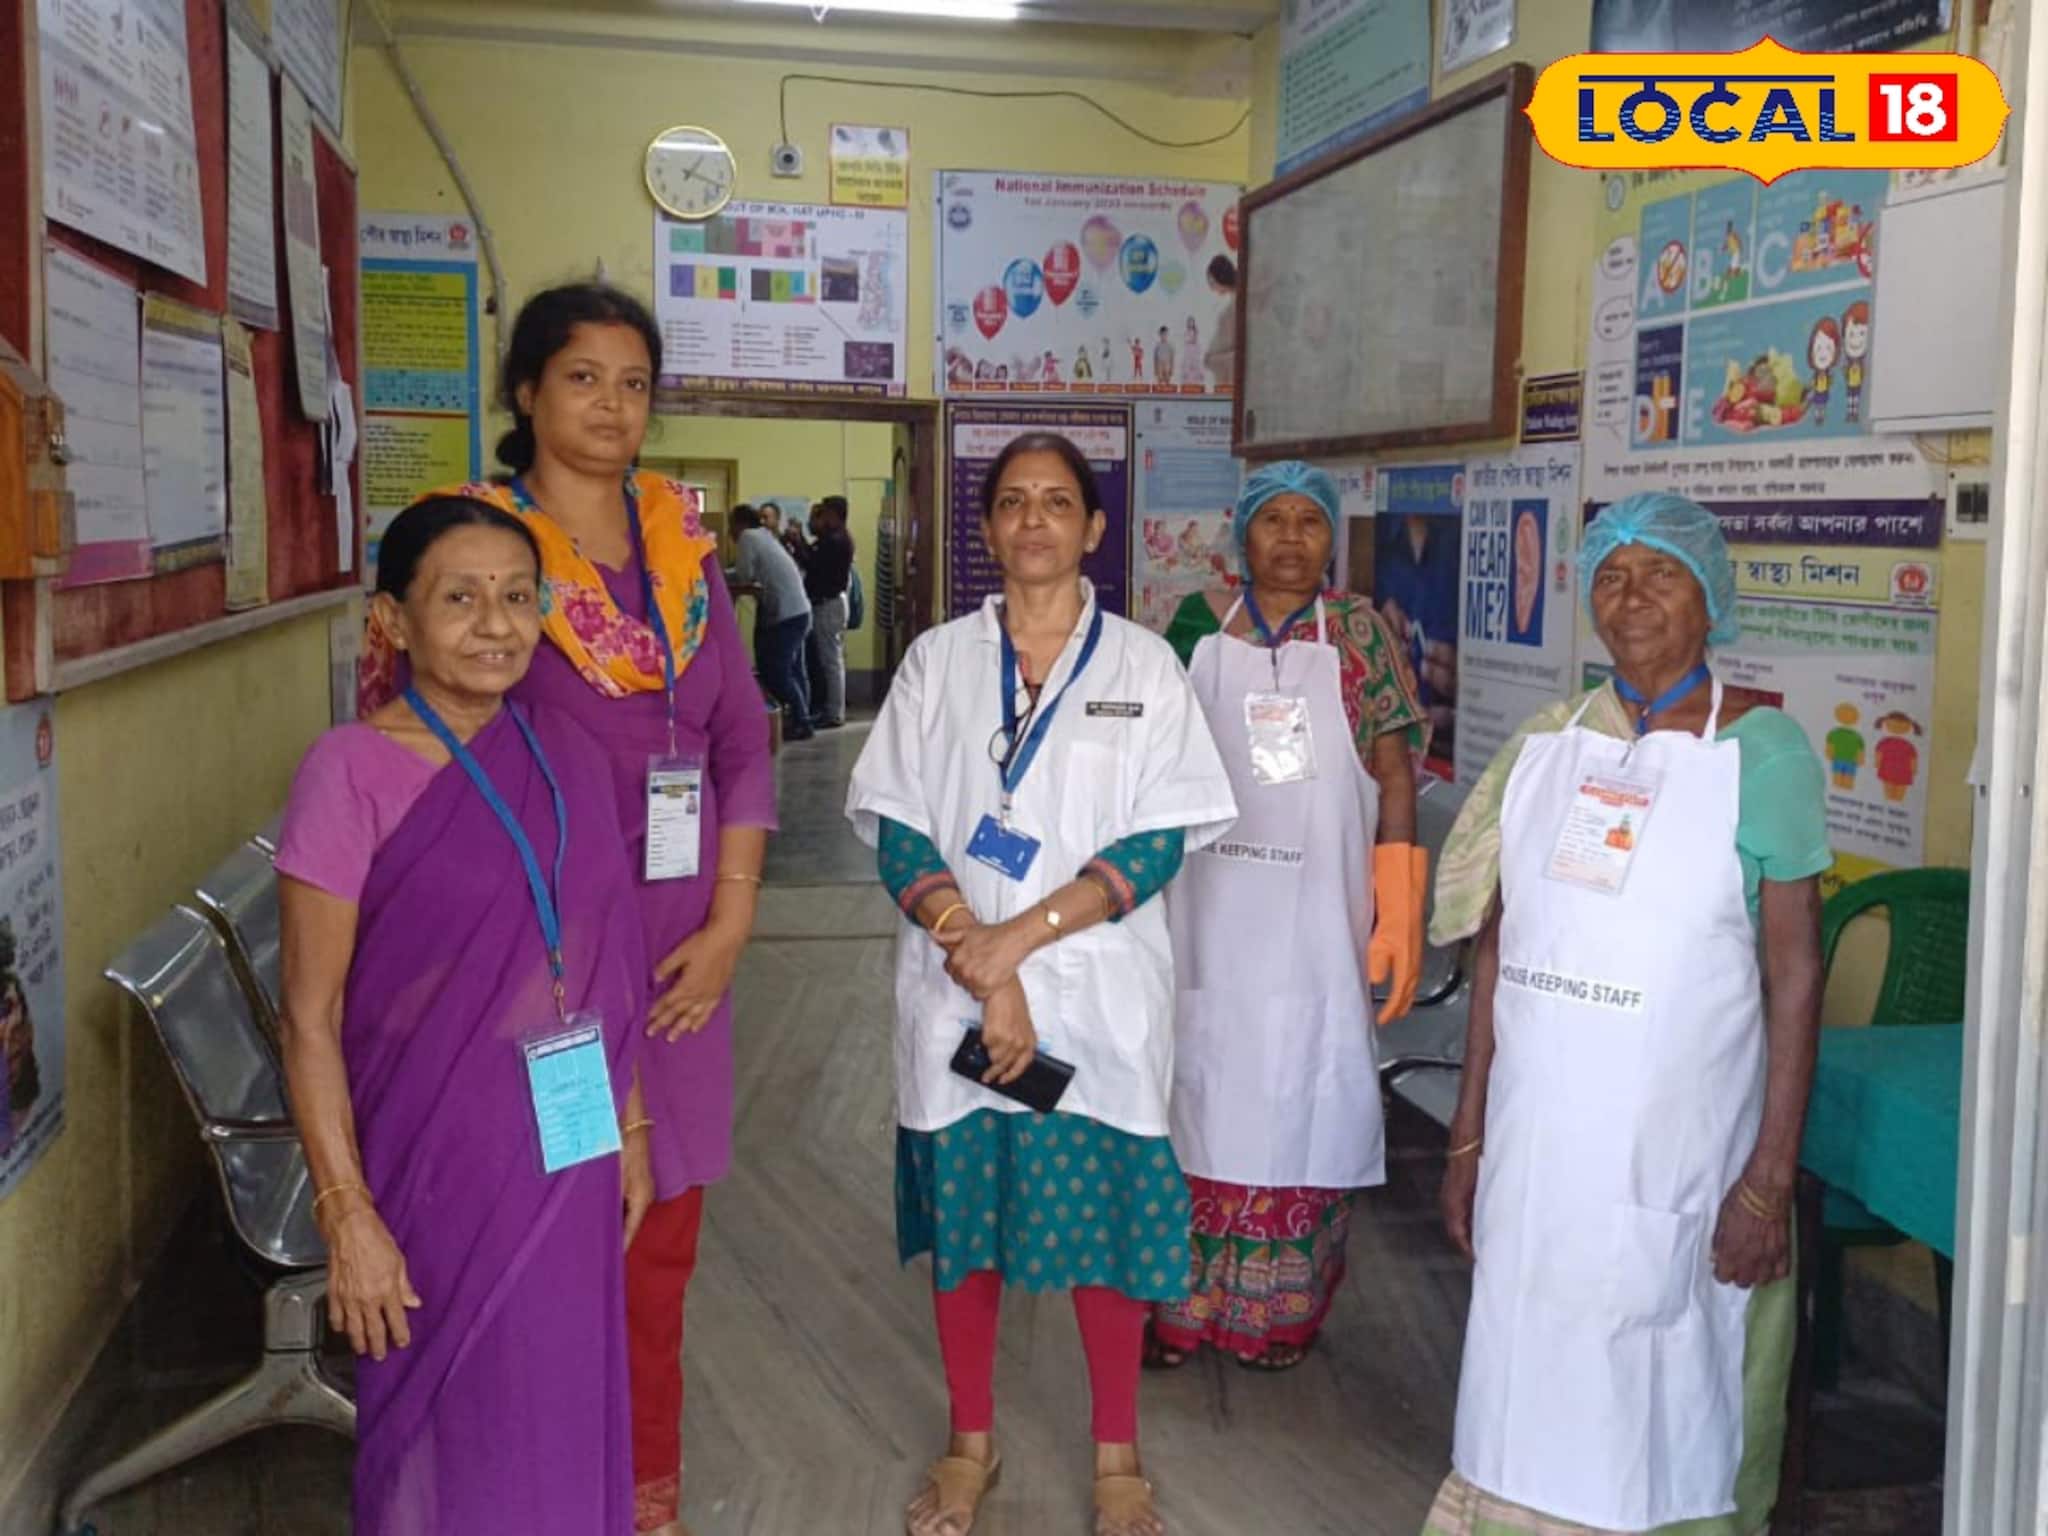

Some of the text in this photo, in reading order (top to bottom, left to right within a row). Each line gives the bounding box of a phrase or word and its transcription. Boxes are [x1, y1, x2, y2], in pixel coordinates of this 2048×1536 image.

[995, 178, 1207, 198] National Immunization Schedule
[1798, 514, 1867, 535] আপনার
[1874, 513, 1924, 535] পাশে
[1467, 530, 1508, 579] HEAR
[1747, 554, 1860, 585] স্বাস্থ্য মিশন
[1465, 580, 1507, 643] ME?
[1529, 971, 1589, 999] KEEPING
[1591, 983, 1643, 1009] STAFF
